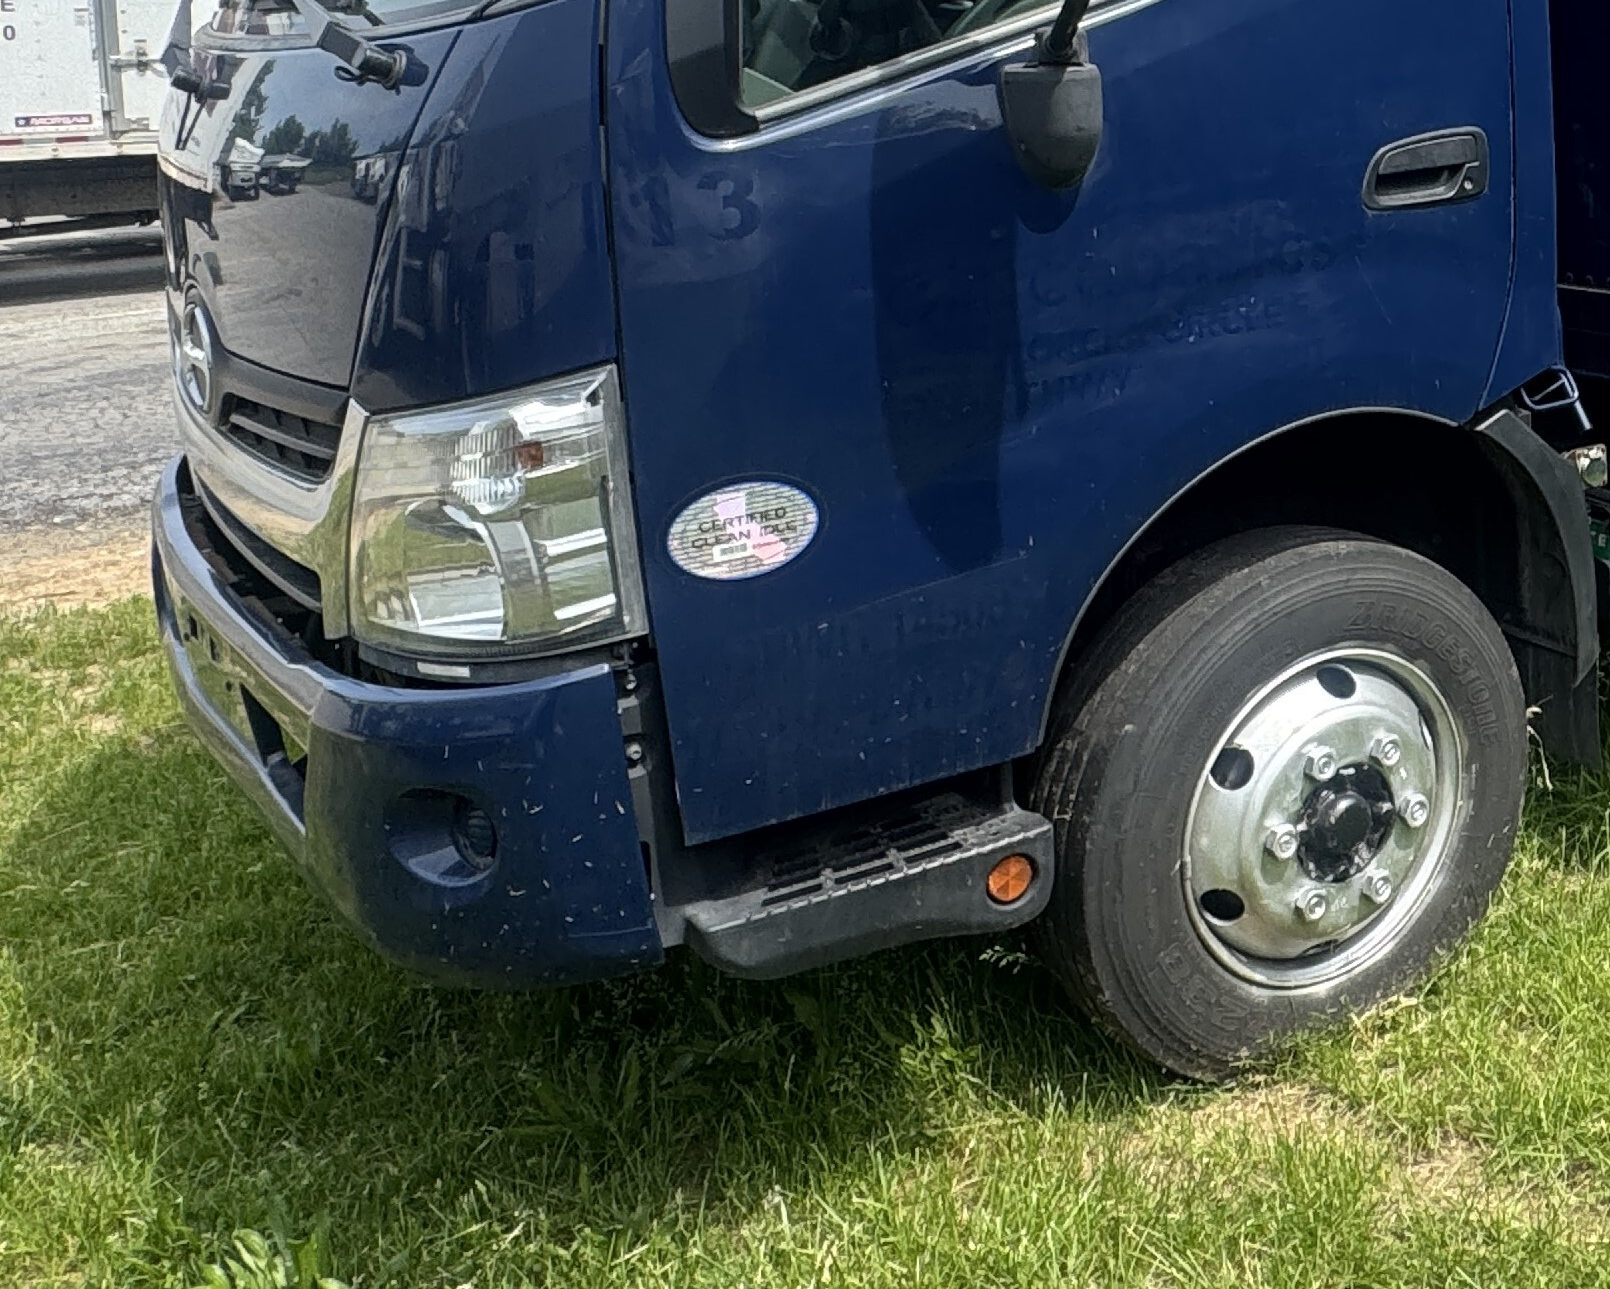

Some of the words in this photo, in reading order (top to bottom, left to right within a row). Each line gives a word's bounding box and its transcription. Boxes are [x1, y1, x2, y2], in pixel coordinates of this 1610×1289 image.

[699, 506, 787, 533] CERTIFIED
[691, 528, 751, 549] CLEAN
[1343, 599, 1500, 747] BRIDGESTONE
